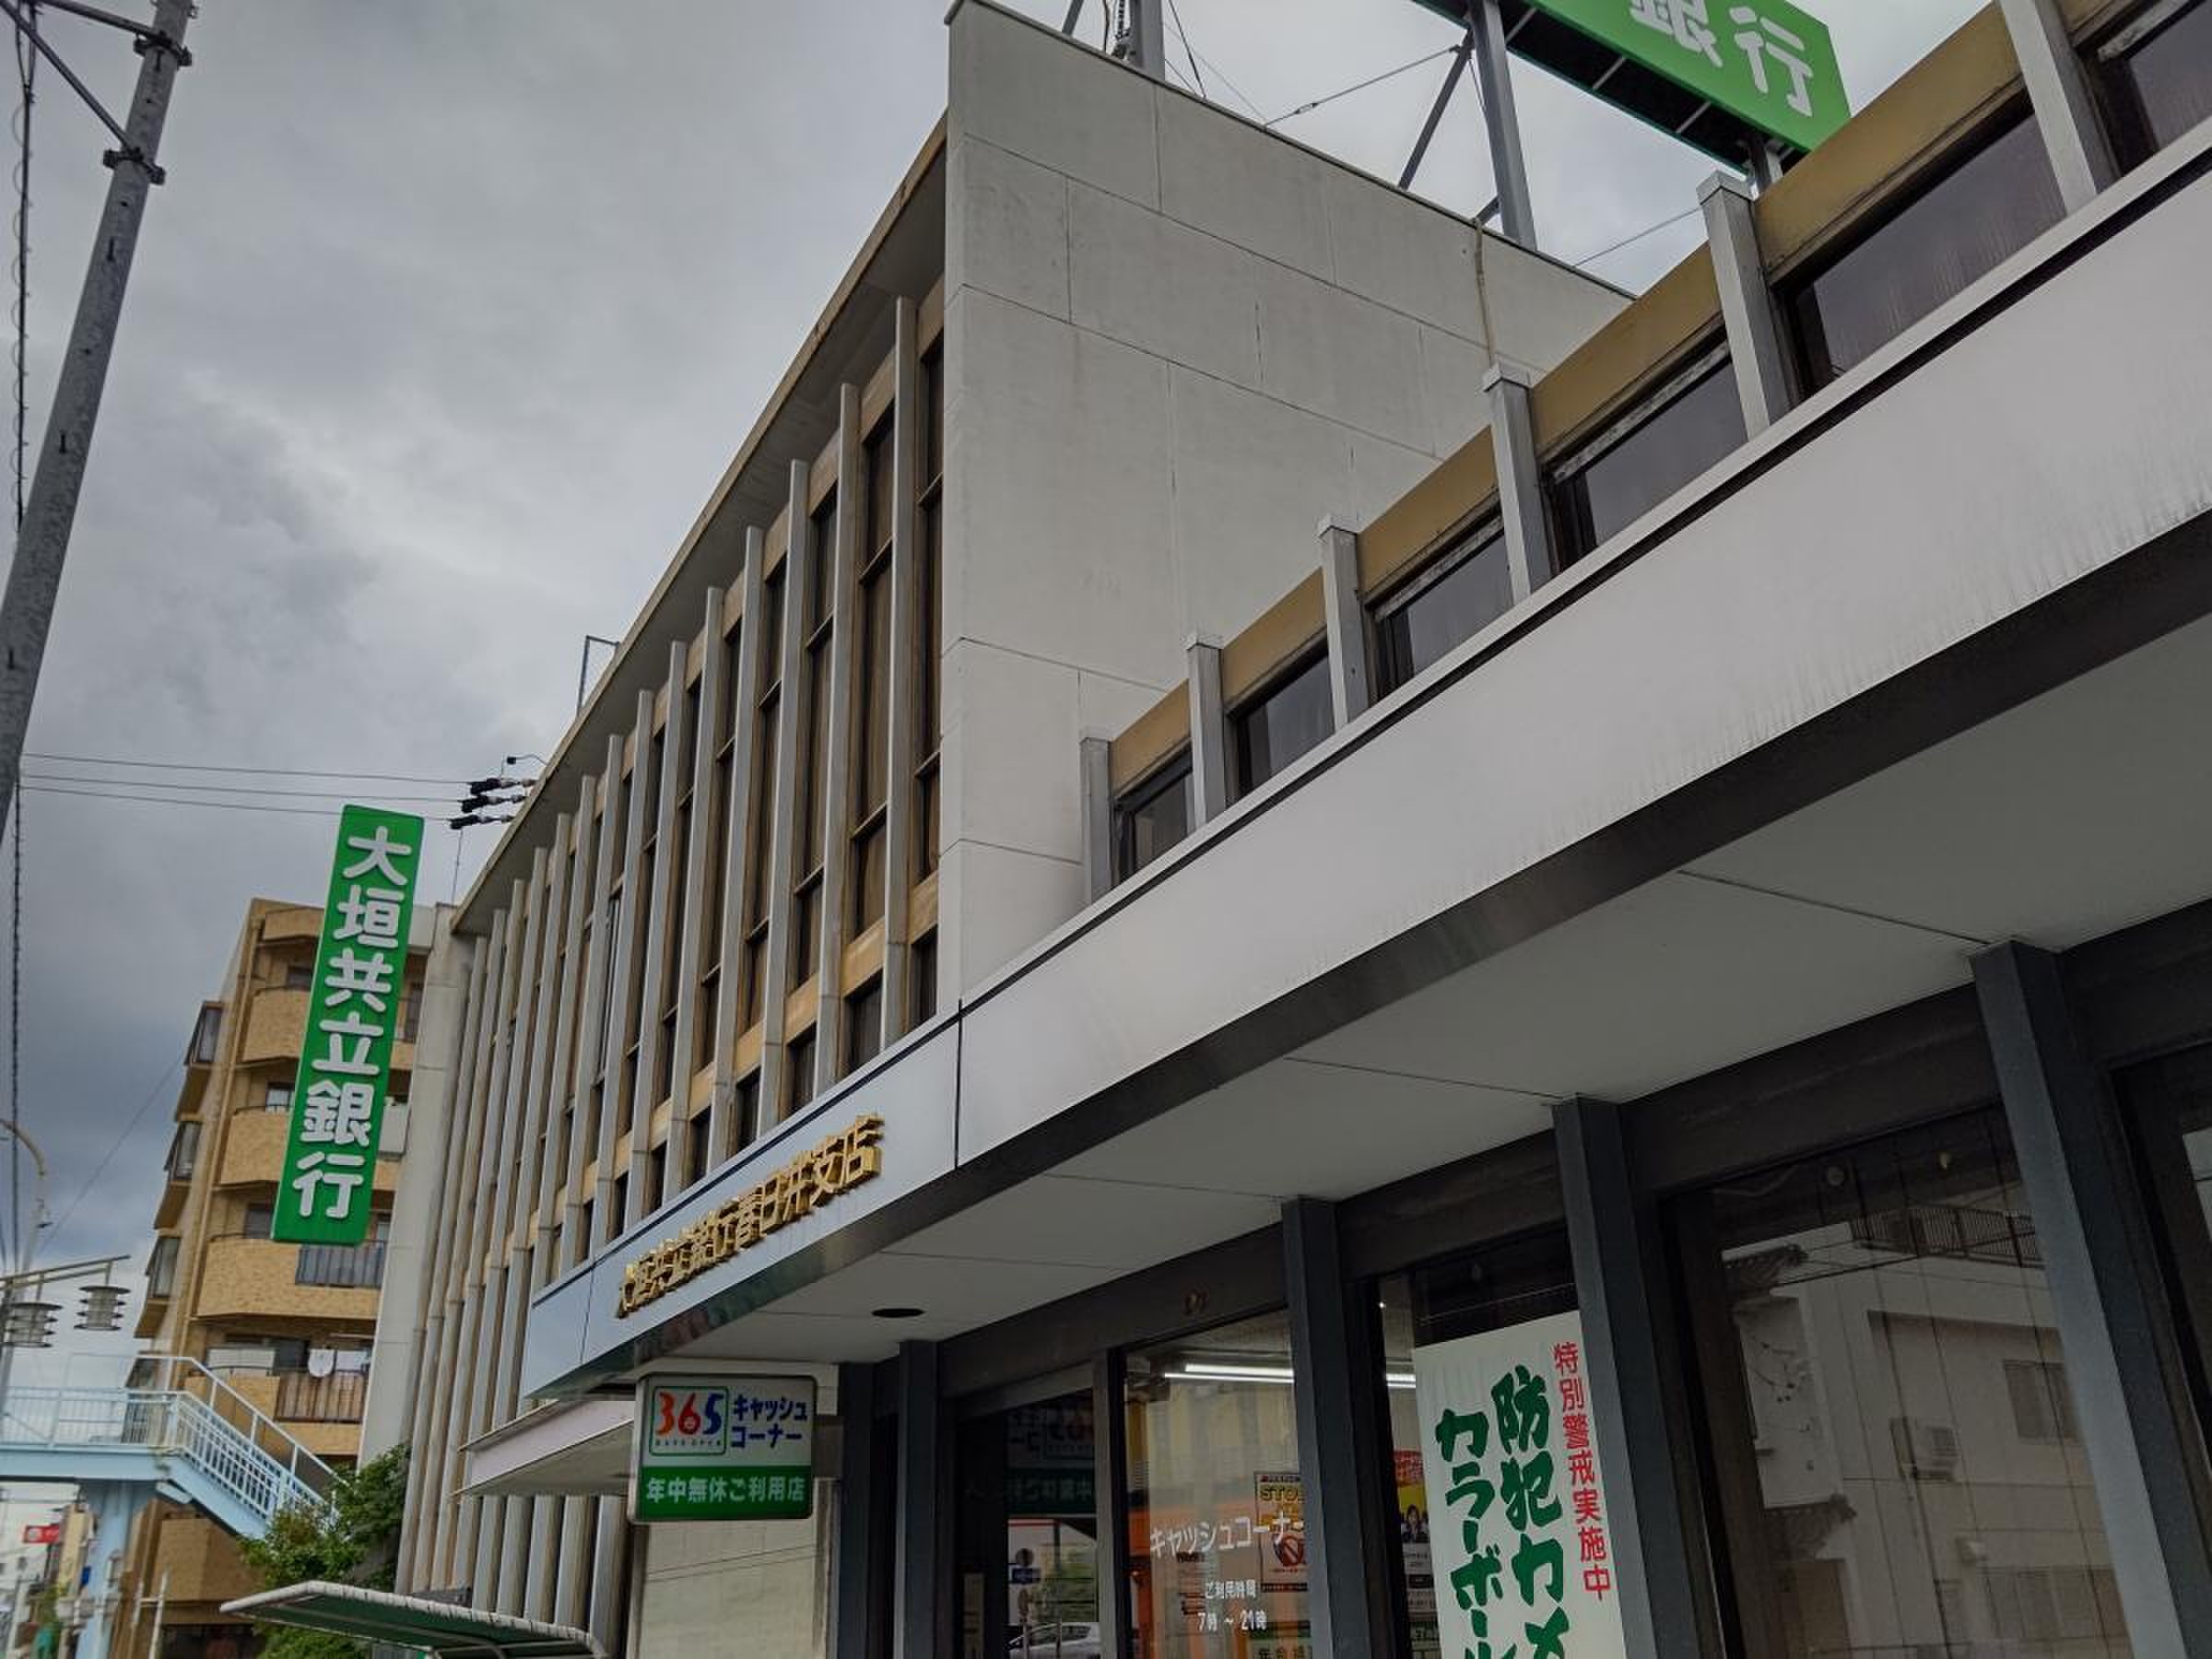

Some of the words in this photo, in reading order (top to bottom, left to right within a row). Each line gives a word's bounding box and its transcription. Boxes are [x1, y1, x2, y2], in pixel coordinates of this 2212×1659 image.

[292, 825, 412, 1220] 大垣共立銀行
[655, 1392, 724, 1436] 365
[733, 1394, 807, 1421] キャッシュ
[731, 1423, 802, 1448] コーナー
[647, 1477, 806, 1503] 年中無休ご利用店
[1553, 1341, 1611, 1601] 特別警戒実施中
[1435, 1408, 1517, 1659] カラーボー
